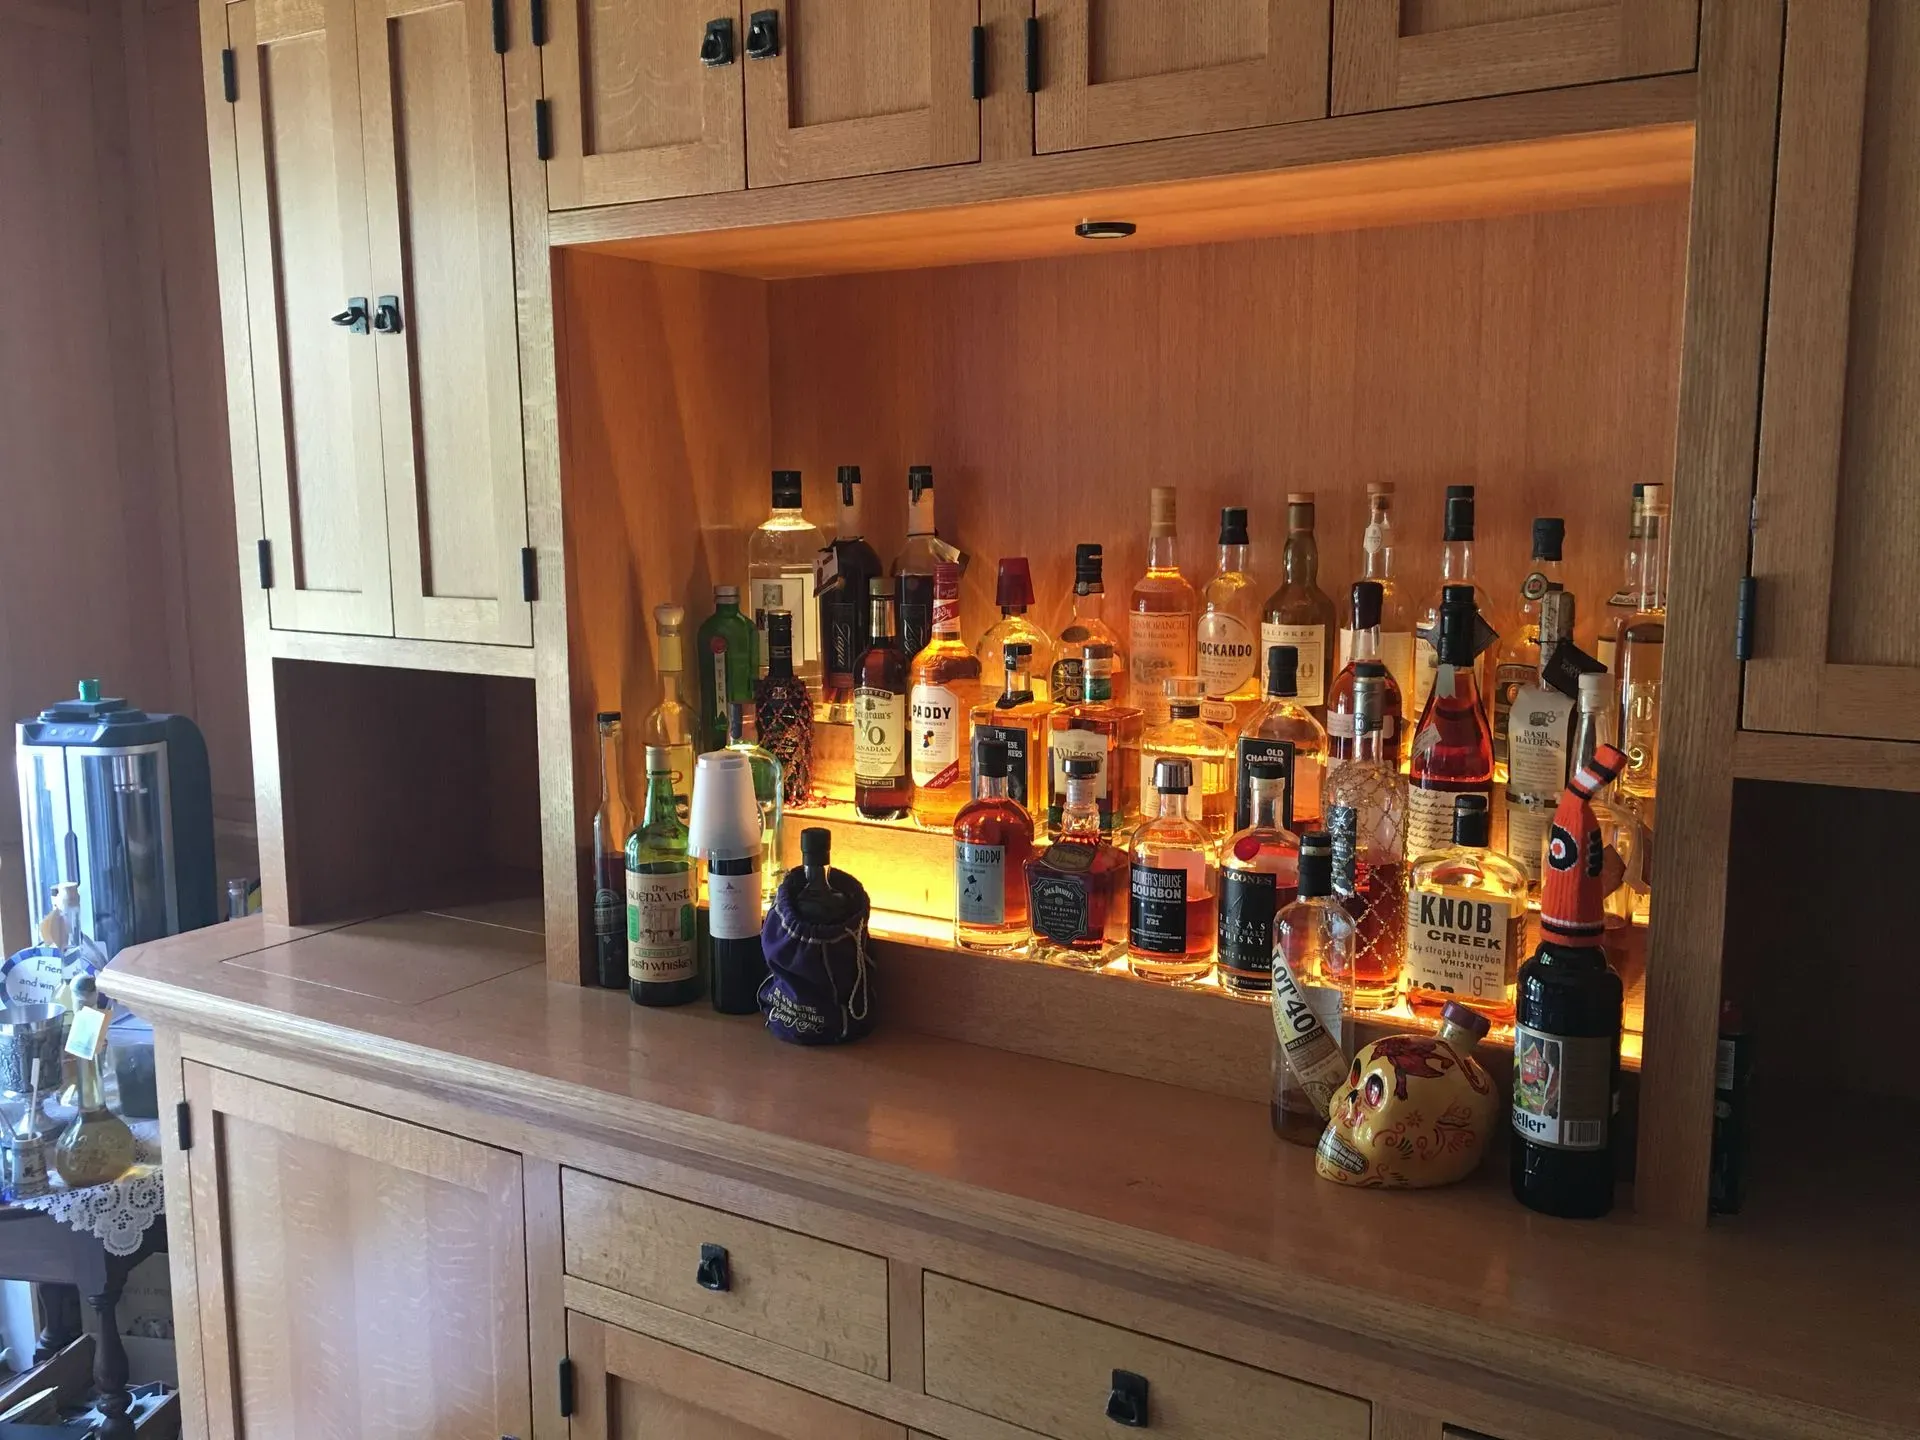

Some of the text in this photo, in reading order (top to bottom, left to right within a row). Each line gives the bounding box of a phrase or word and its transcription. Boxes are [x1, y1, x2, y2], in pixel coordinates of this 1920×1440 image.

[1199, 641, 1252, 657] OCKANDO
[912, 704, 952, 720] PADDY
[995, 730, 1007, 740] THE
[1515, 735, 1560, 748] HAYDEN'S
[1524, 729, 1550, 740] BASIL
[1266, 748, 1284, 757] OLD
[974, 849, 1001, 864] DADDY
[1158, 873, 1182, 888] HOUSE
[1132, 882, 1182, 899] BOURBON
[1219, 912, 1266, 930] TEXAS
[1420, 894, 1492, 934] KNOB
[1219, 928, 1265, 946] WHISKY
[1427, 929, 1502, 951] CREEK
[1425, 944, 1461, 960] straight
[1464, 950, 1501, 965] bourbon
[36, 959, 62, 974] Frien
[1440, 957, 1484, 971] WHISKEY
[1444, 969, 1464, 980] batch
[19, 977, 38, 988] and
[1472, 975, 1482, 997] 9
[1272, 949, 1298, 998] LOT
[1285, 1000, 1317, 1033] 40
